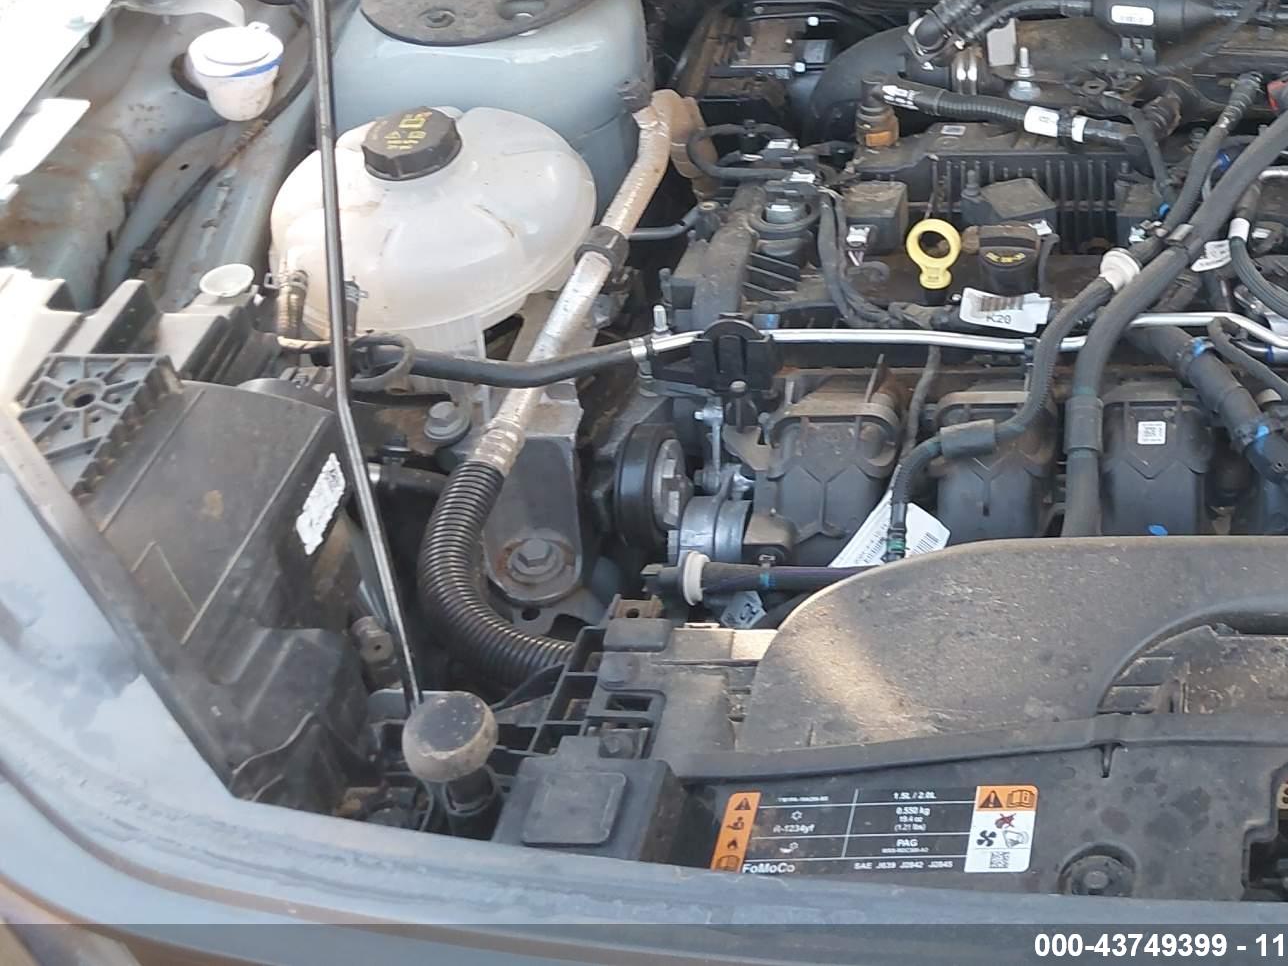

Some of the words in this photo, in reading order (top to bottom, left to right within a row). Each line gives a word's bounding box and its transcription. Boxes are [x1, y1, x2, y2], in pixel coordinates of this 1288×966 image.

[919, 806, 931, 816] kg
[773, 824, 815, 834] R-1234yf
[896, 839, 919, 847] PAG
[742, 862, 796, 874] FoMoCo
[854, 862, 873, 870] SAE
